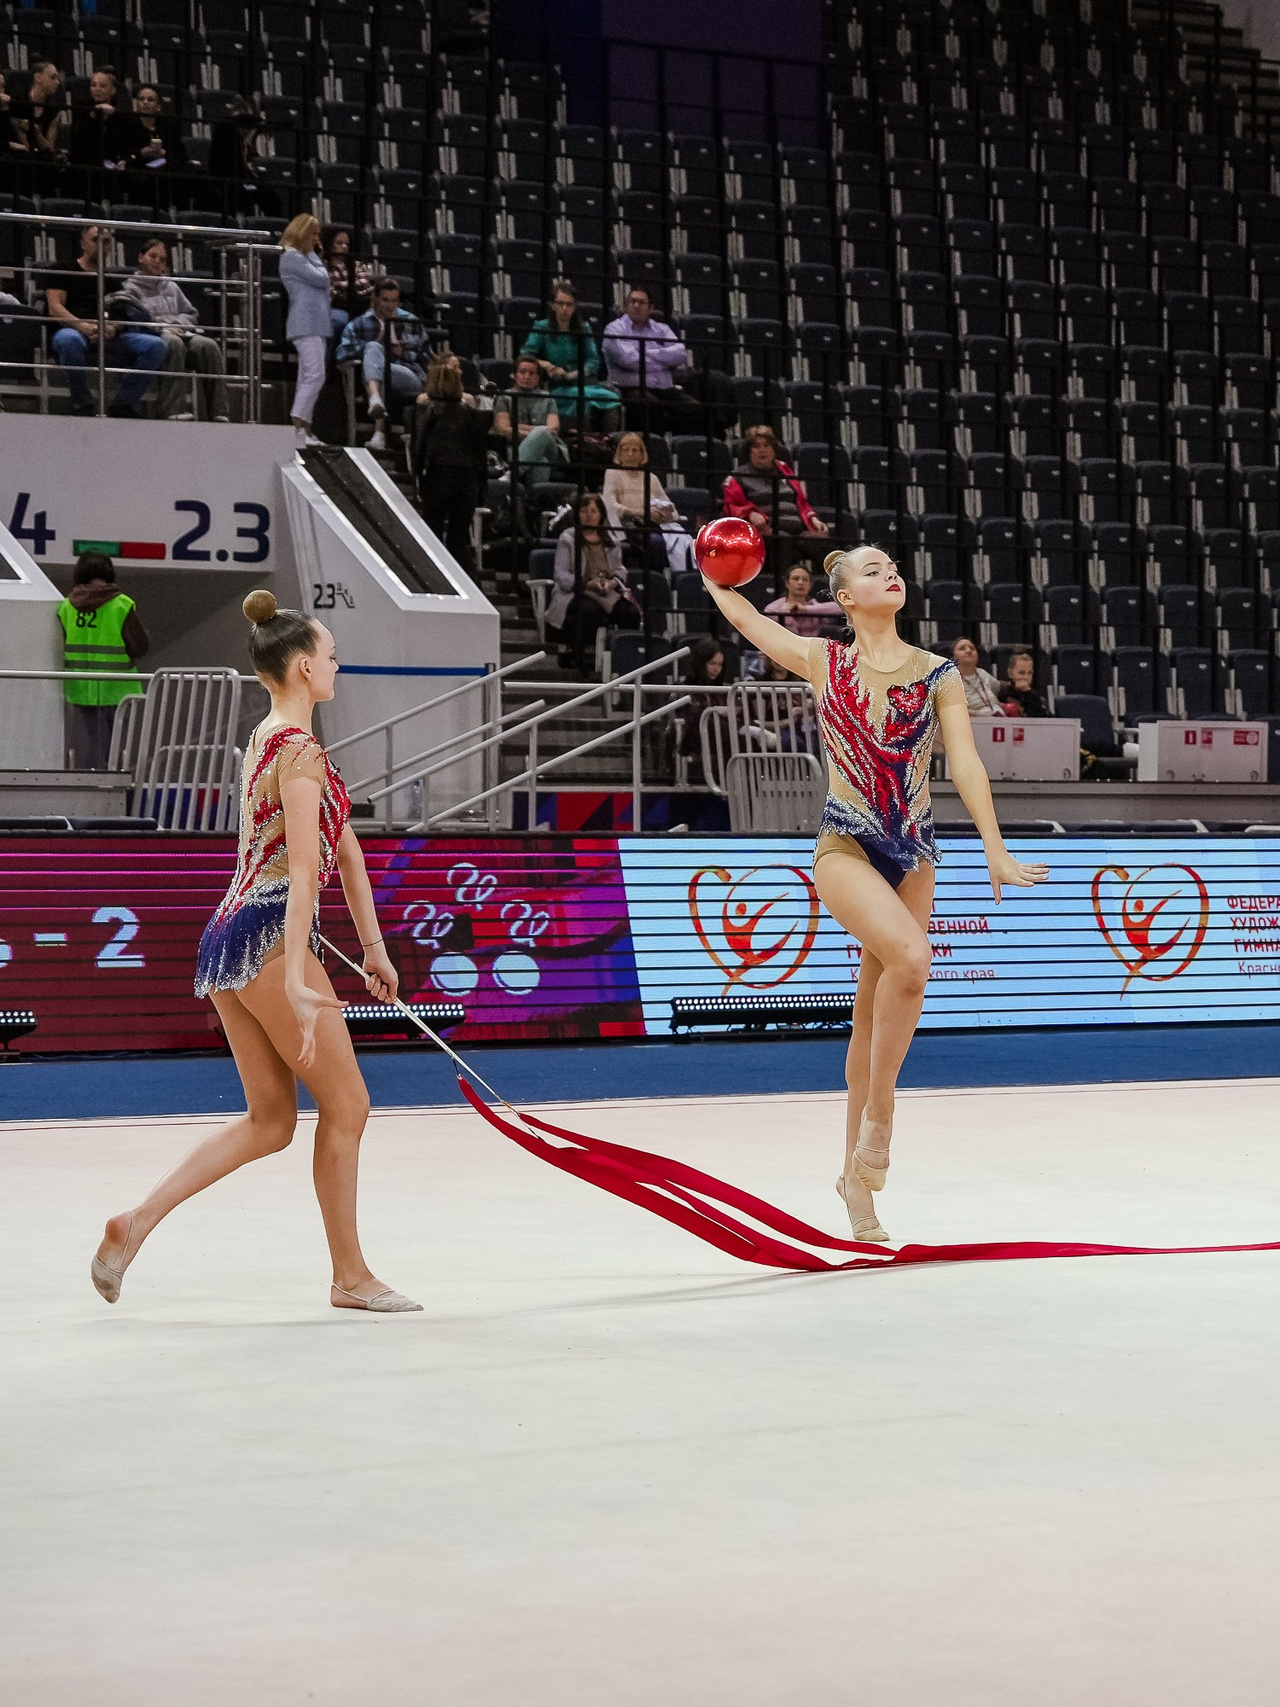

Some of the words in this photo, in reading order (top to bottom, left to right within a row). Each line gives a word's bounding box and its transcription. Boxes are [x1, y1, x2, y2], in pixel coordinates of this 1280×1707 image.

[172, 500, 271, 562] 2.3
[75, 610, 97, 628] 82
[91, 907, 146, 968] 2
[963, 969, 995, 984] края
